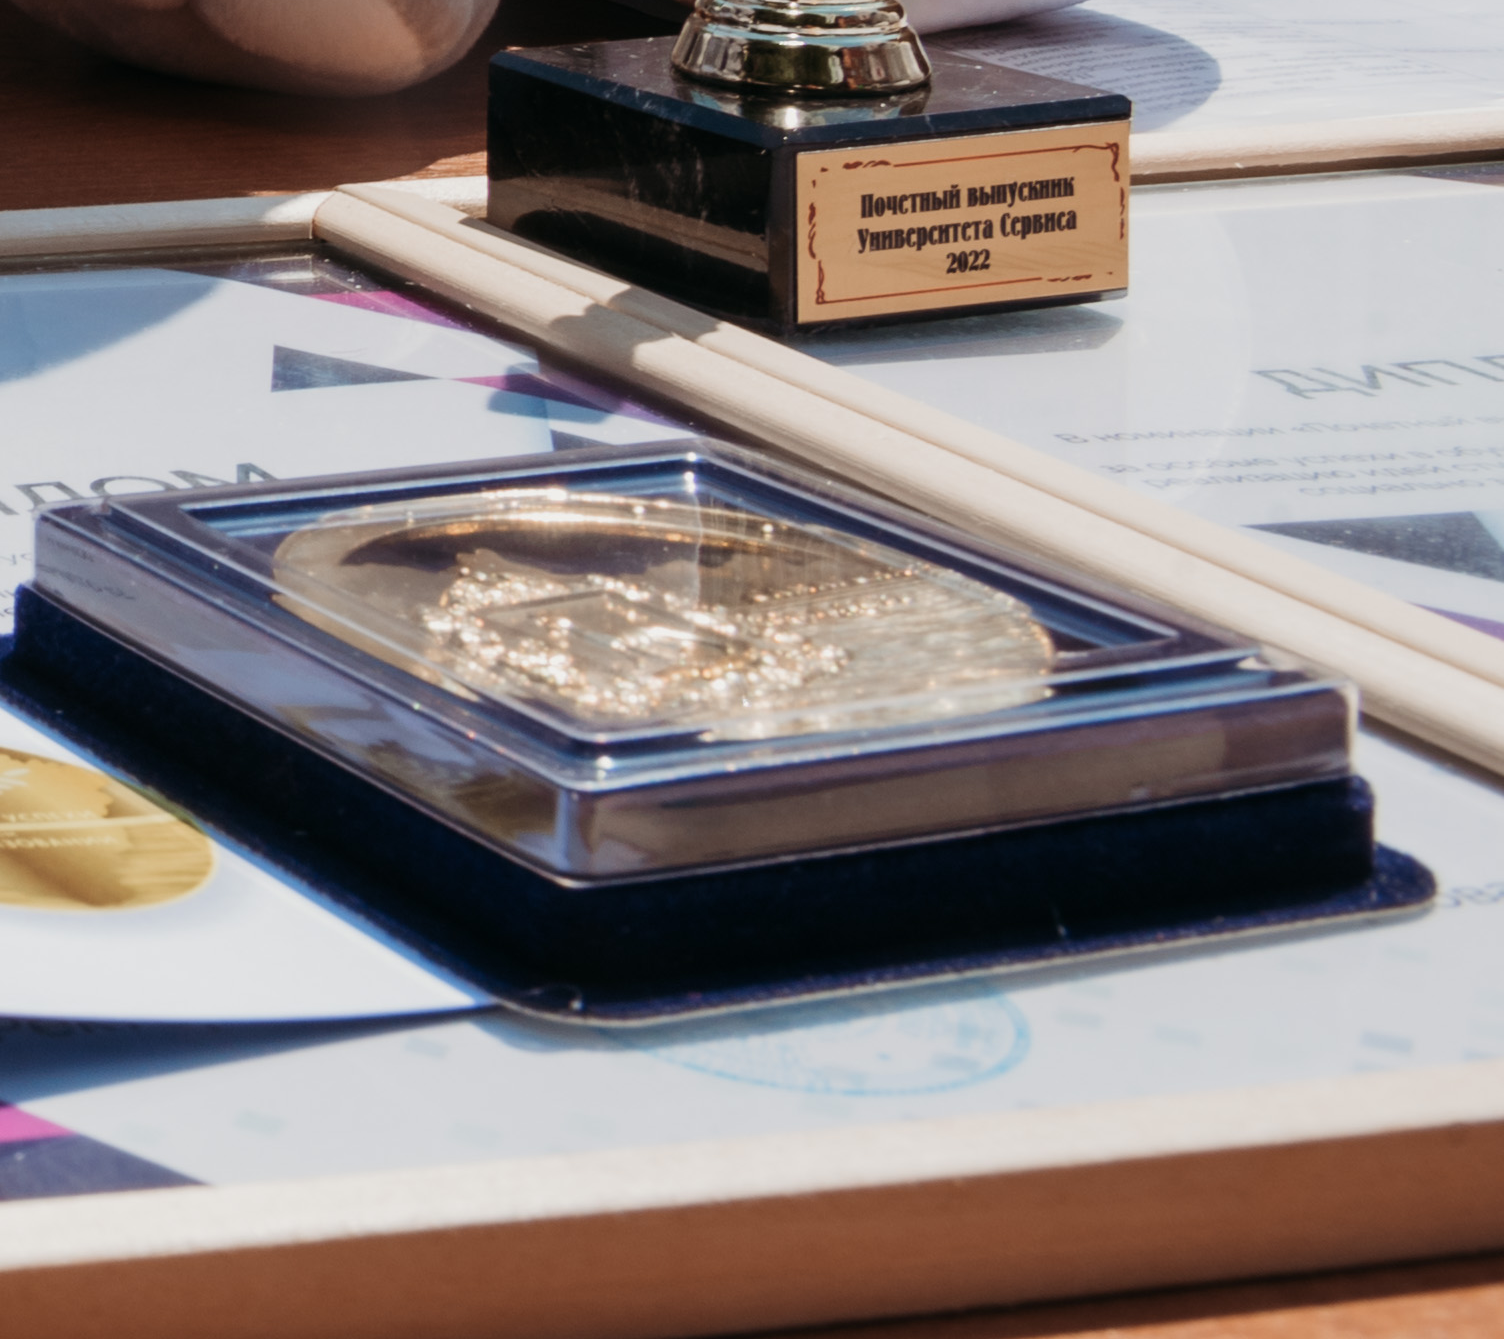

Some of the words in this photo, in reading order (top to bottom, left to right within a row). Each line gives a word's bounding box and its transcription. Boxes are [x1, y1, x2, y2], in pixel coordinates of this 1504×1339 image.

[860, 185, 961, 219] Почетный
[967, 176, 1075, 210] выпускник
[858, 219, 994, 254] Университета
[1000, 210, 1077, 241] Сервиса
[946, 249, 991, 274] 2022
[1249, 354, 1504, 399] ДИП
